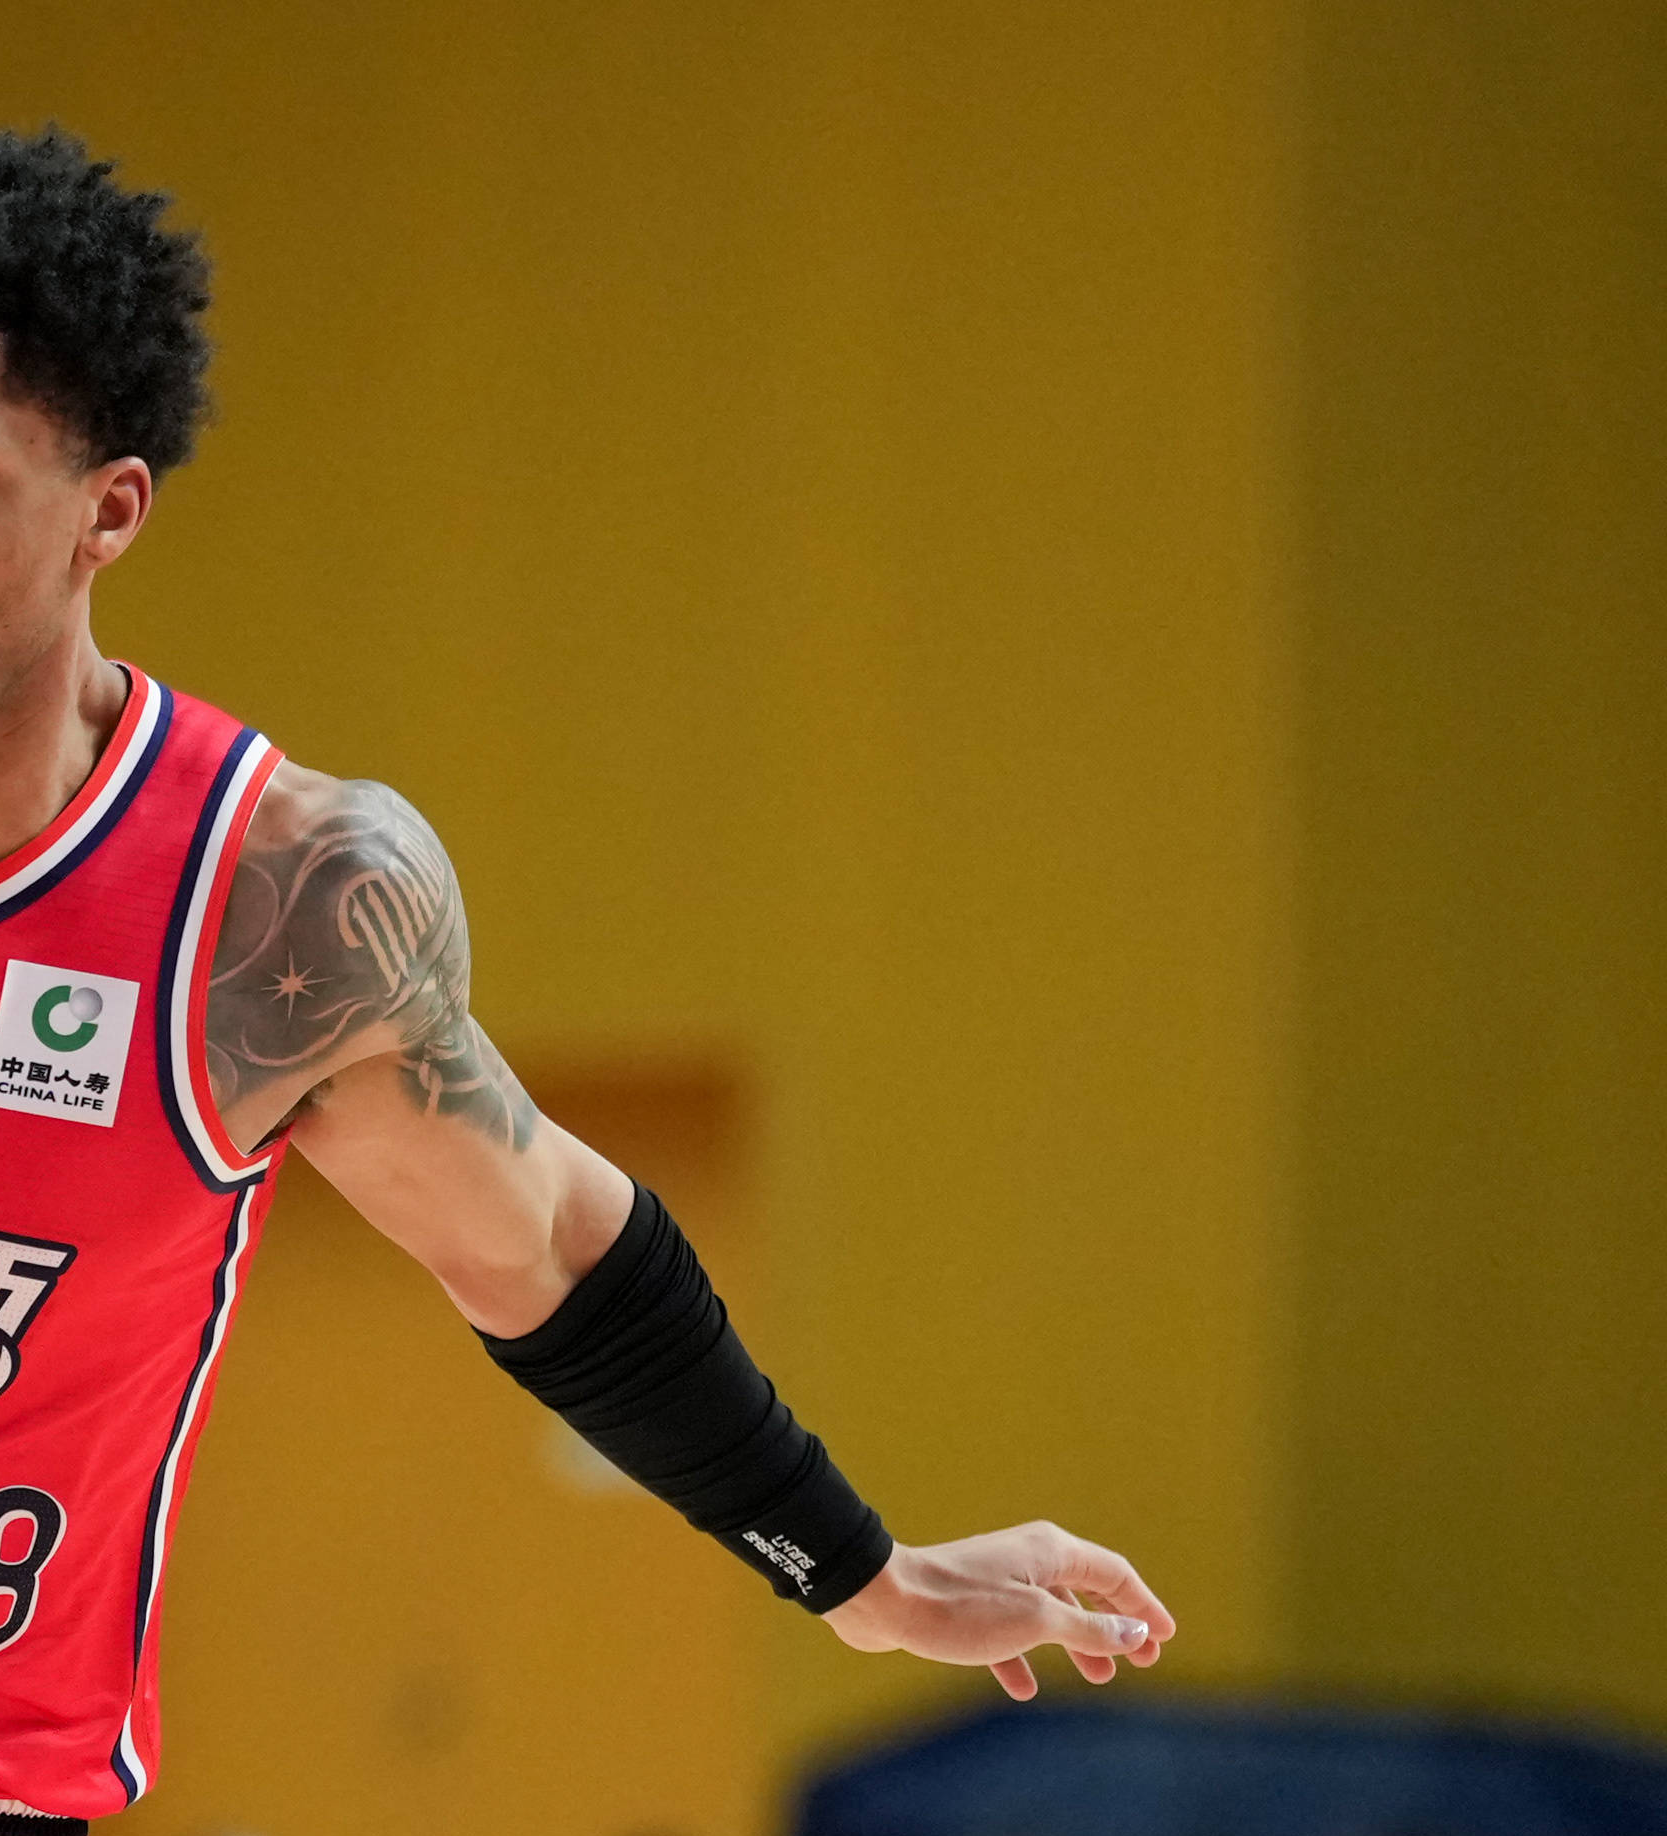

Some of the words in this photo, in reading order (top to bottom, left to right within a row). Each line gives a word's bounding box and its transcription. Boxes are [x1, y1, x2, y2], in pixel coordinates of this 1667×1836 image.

[0, 1057, 110, 1094] 中国人寿
[63, 1094, 104, 1111] LIFE
[741, 1530, 814, 1597] BASKETBALL
